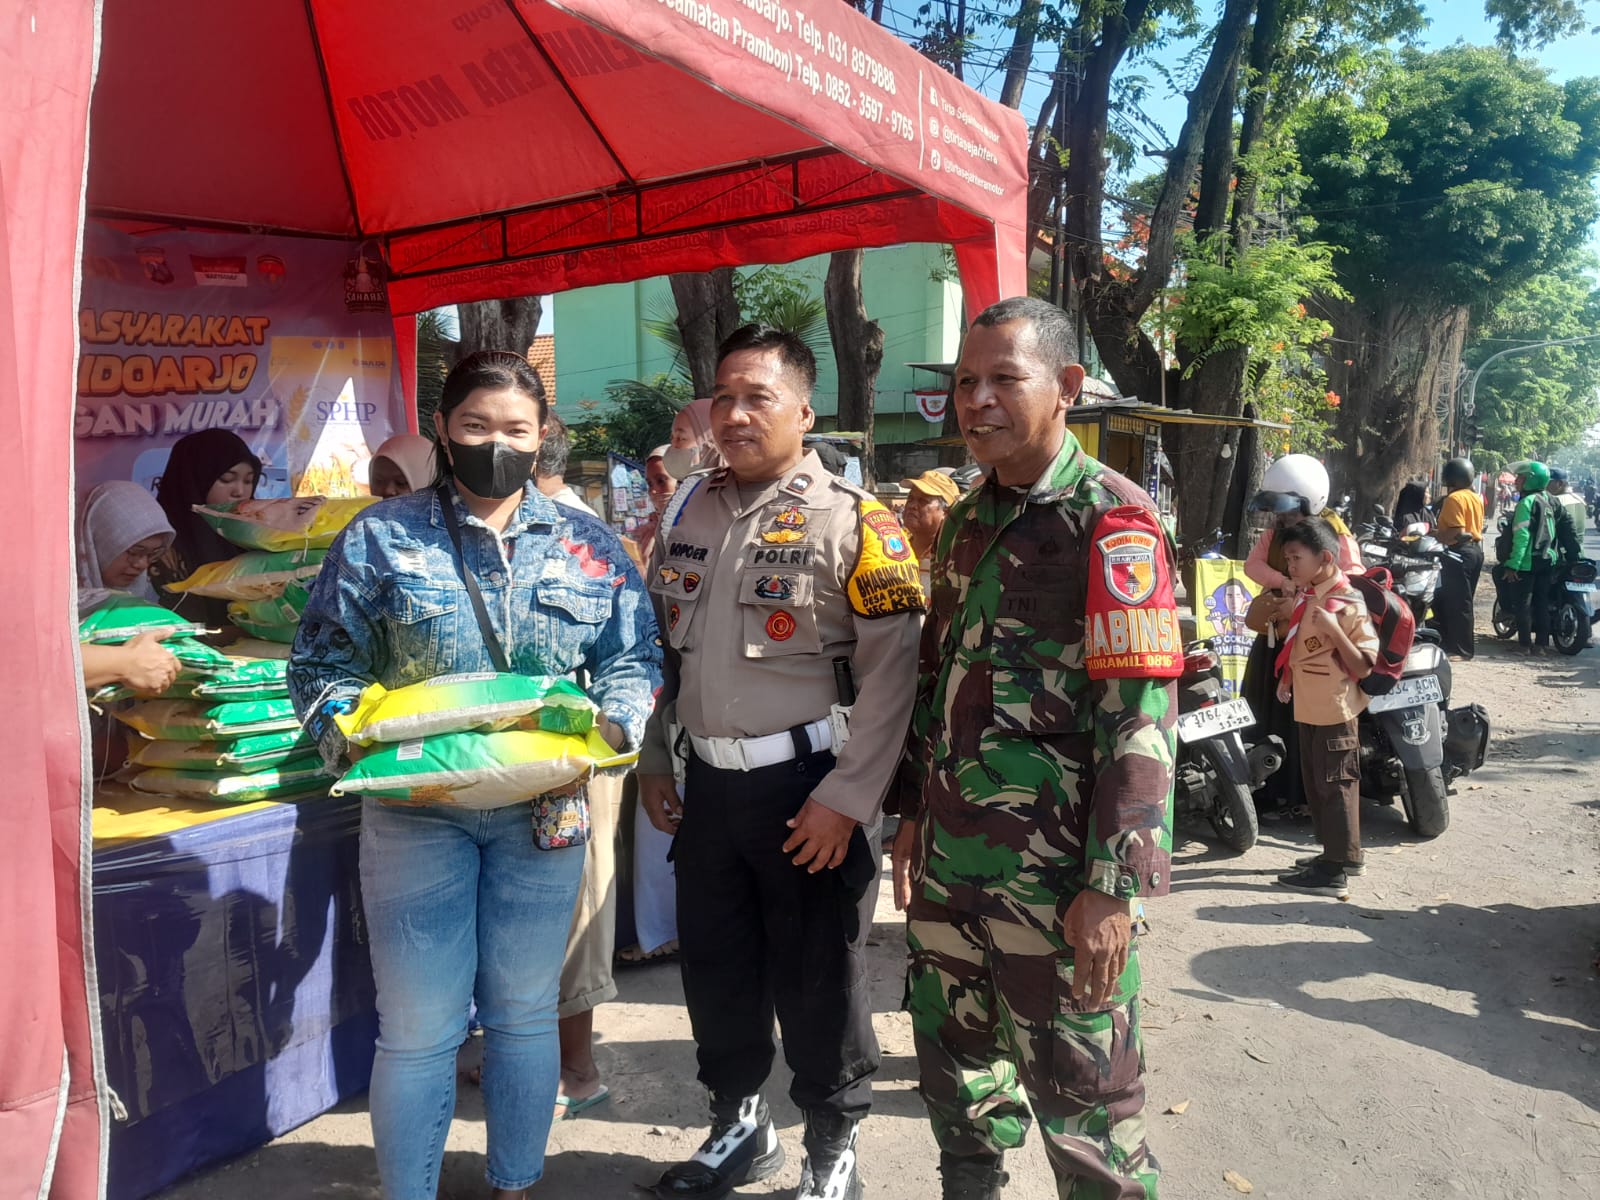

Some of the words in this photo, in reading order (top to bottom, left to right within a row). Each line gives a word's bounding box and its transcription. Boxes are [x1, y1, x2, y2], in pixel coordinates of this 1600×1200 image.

[795, 10, 825, 56] Telp.
[827, 31, 848, 67] 031
[851, 46, 897, 95] 8979888
[732, 17, 792, 82] Prambon)
[795, 53, 823, 95] Telp.
[825, 72, 851, 108] 0852
[859, 91, 883, 124] 3597
[891, 110, 914, 141] 9765
[163, 398, 281, 434] MURAH
[316, 400, 377, 421] SPHP
[754, 548, 811, 565] POLRI
[862, 591, 887, 608] DESA
[1007, 597, 1037, 611] TNI
